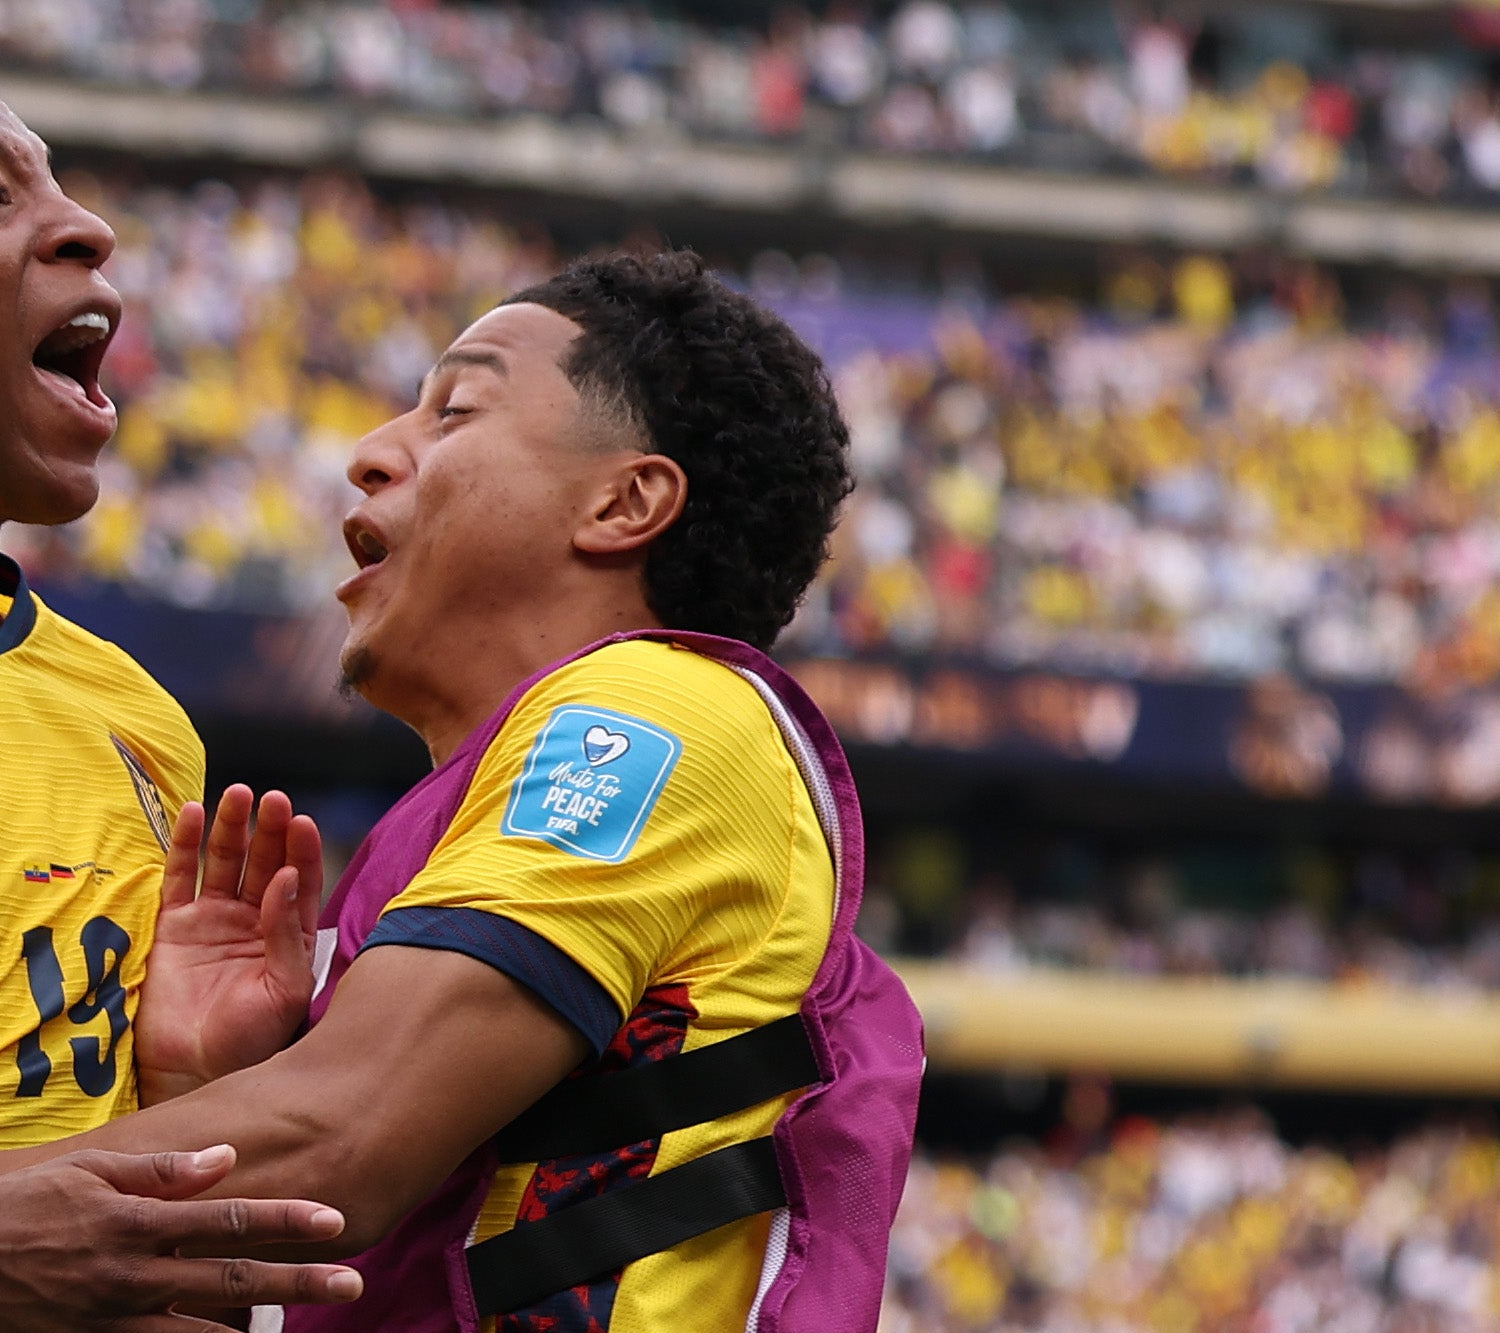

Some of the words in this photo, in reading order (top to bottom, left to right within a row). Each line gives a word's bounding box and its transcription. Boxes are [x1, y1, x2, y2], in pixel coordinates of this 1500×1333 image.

[548, 761, 595, 789] Unite
[592, 774, 622, 798] For
[541, 786, 608, 827] PEACE
[546, 816, 578, 835] FIFA
[15, 915, 131, 1098] 19
